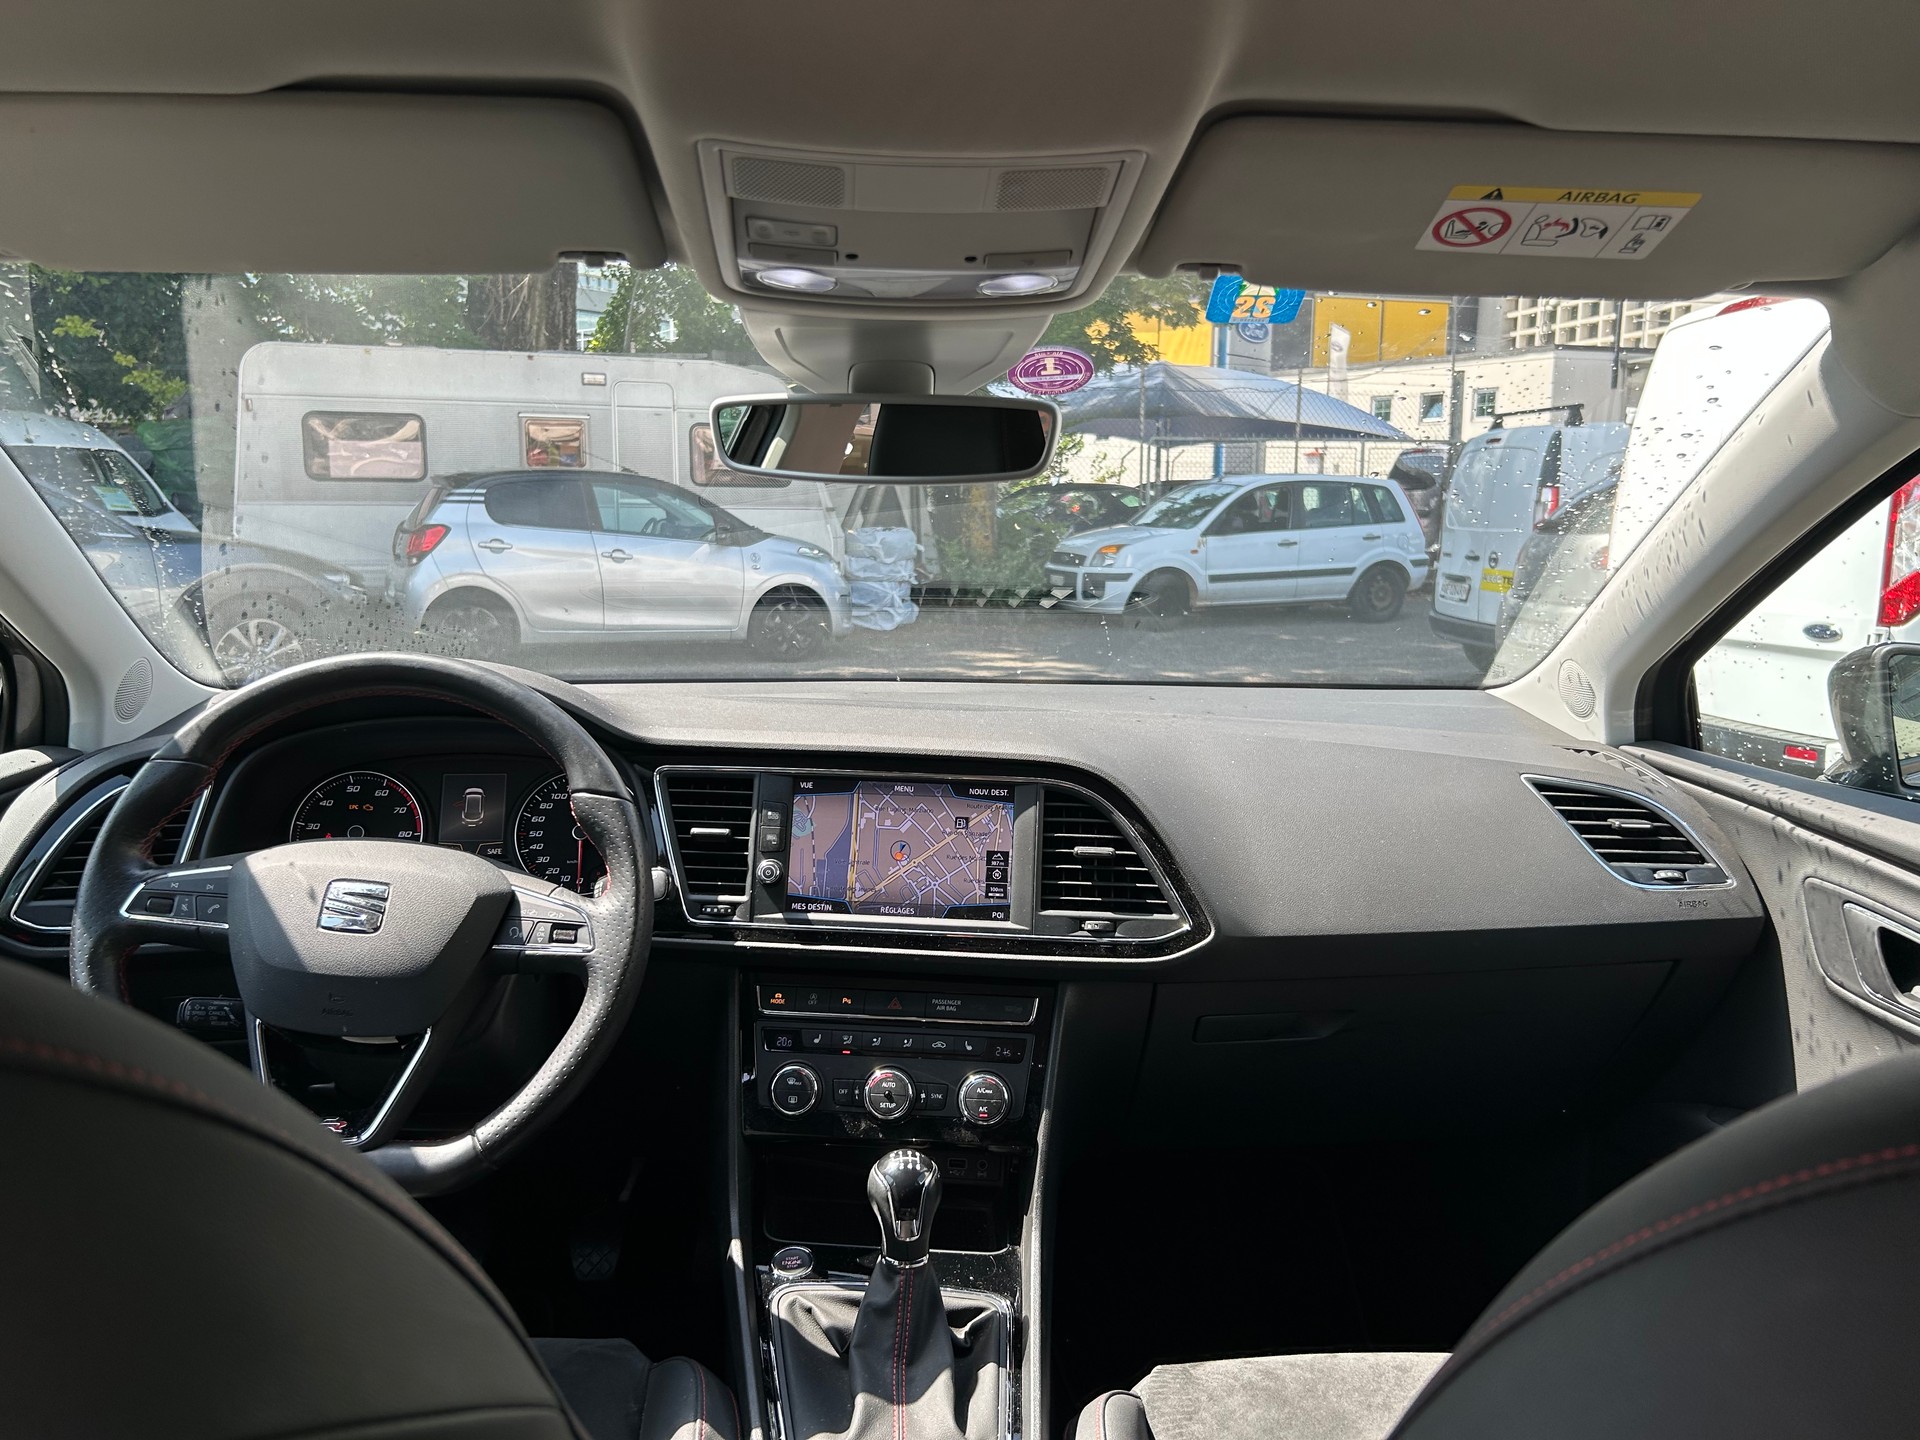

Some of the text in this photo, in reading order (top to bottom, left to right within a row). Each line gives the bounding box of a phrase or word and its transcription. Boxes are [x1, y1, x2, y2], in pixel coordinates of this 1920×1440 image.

[1557, 191, 1640, 204] AIRBAG
[1040, 358, 1062, 375] 1
[375, 789, 389, 797] 60
[894, 785, 914, 793] MENU
[969, 788, 989, 796] NOUV.
[808, 903, 833, 911] DESTIN.
[1678, 900, 1708, 908] AIRBAG
[880, 906, 914, 915] RÉGLAGES
